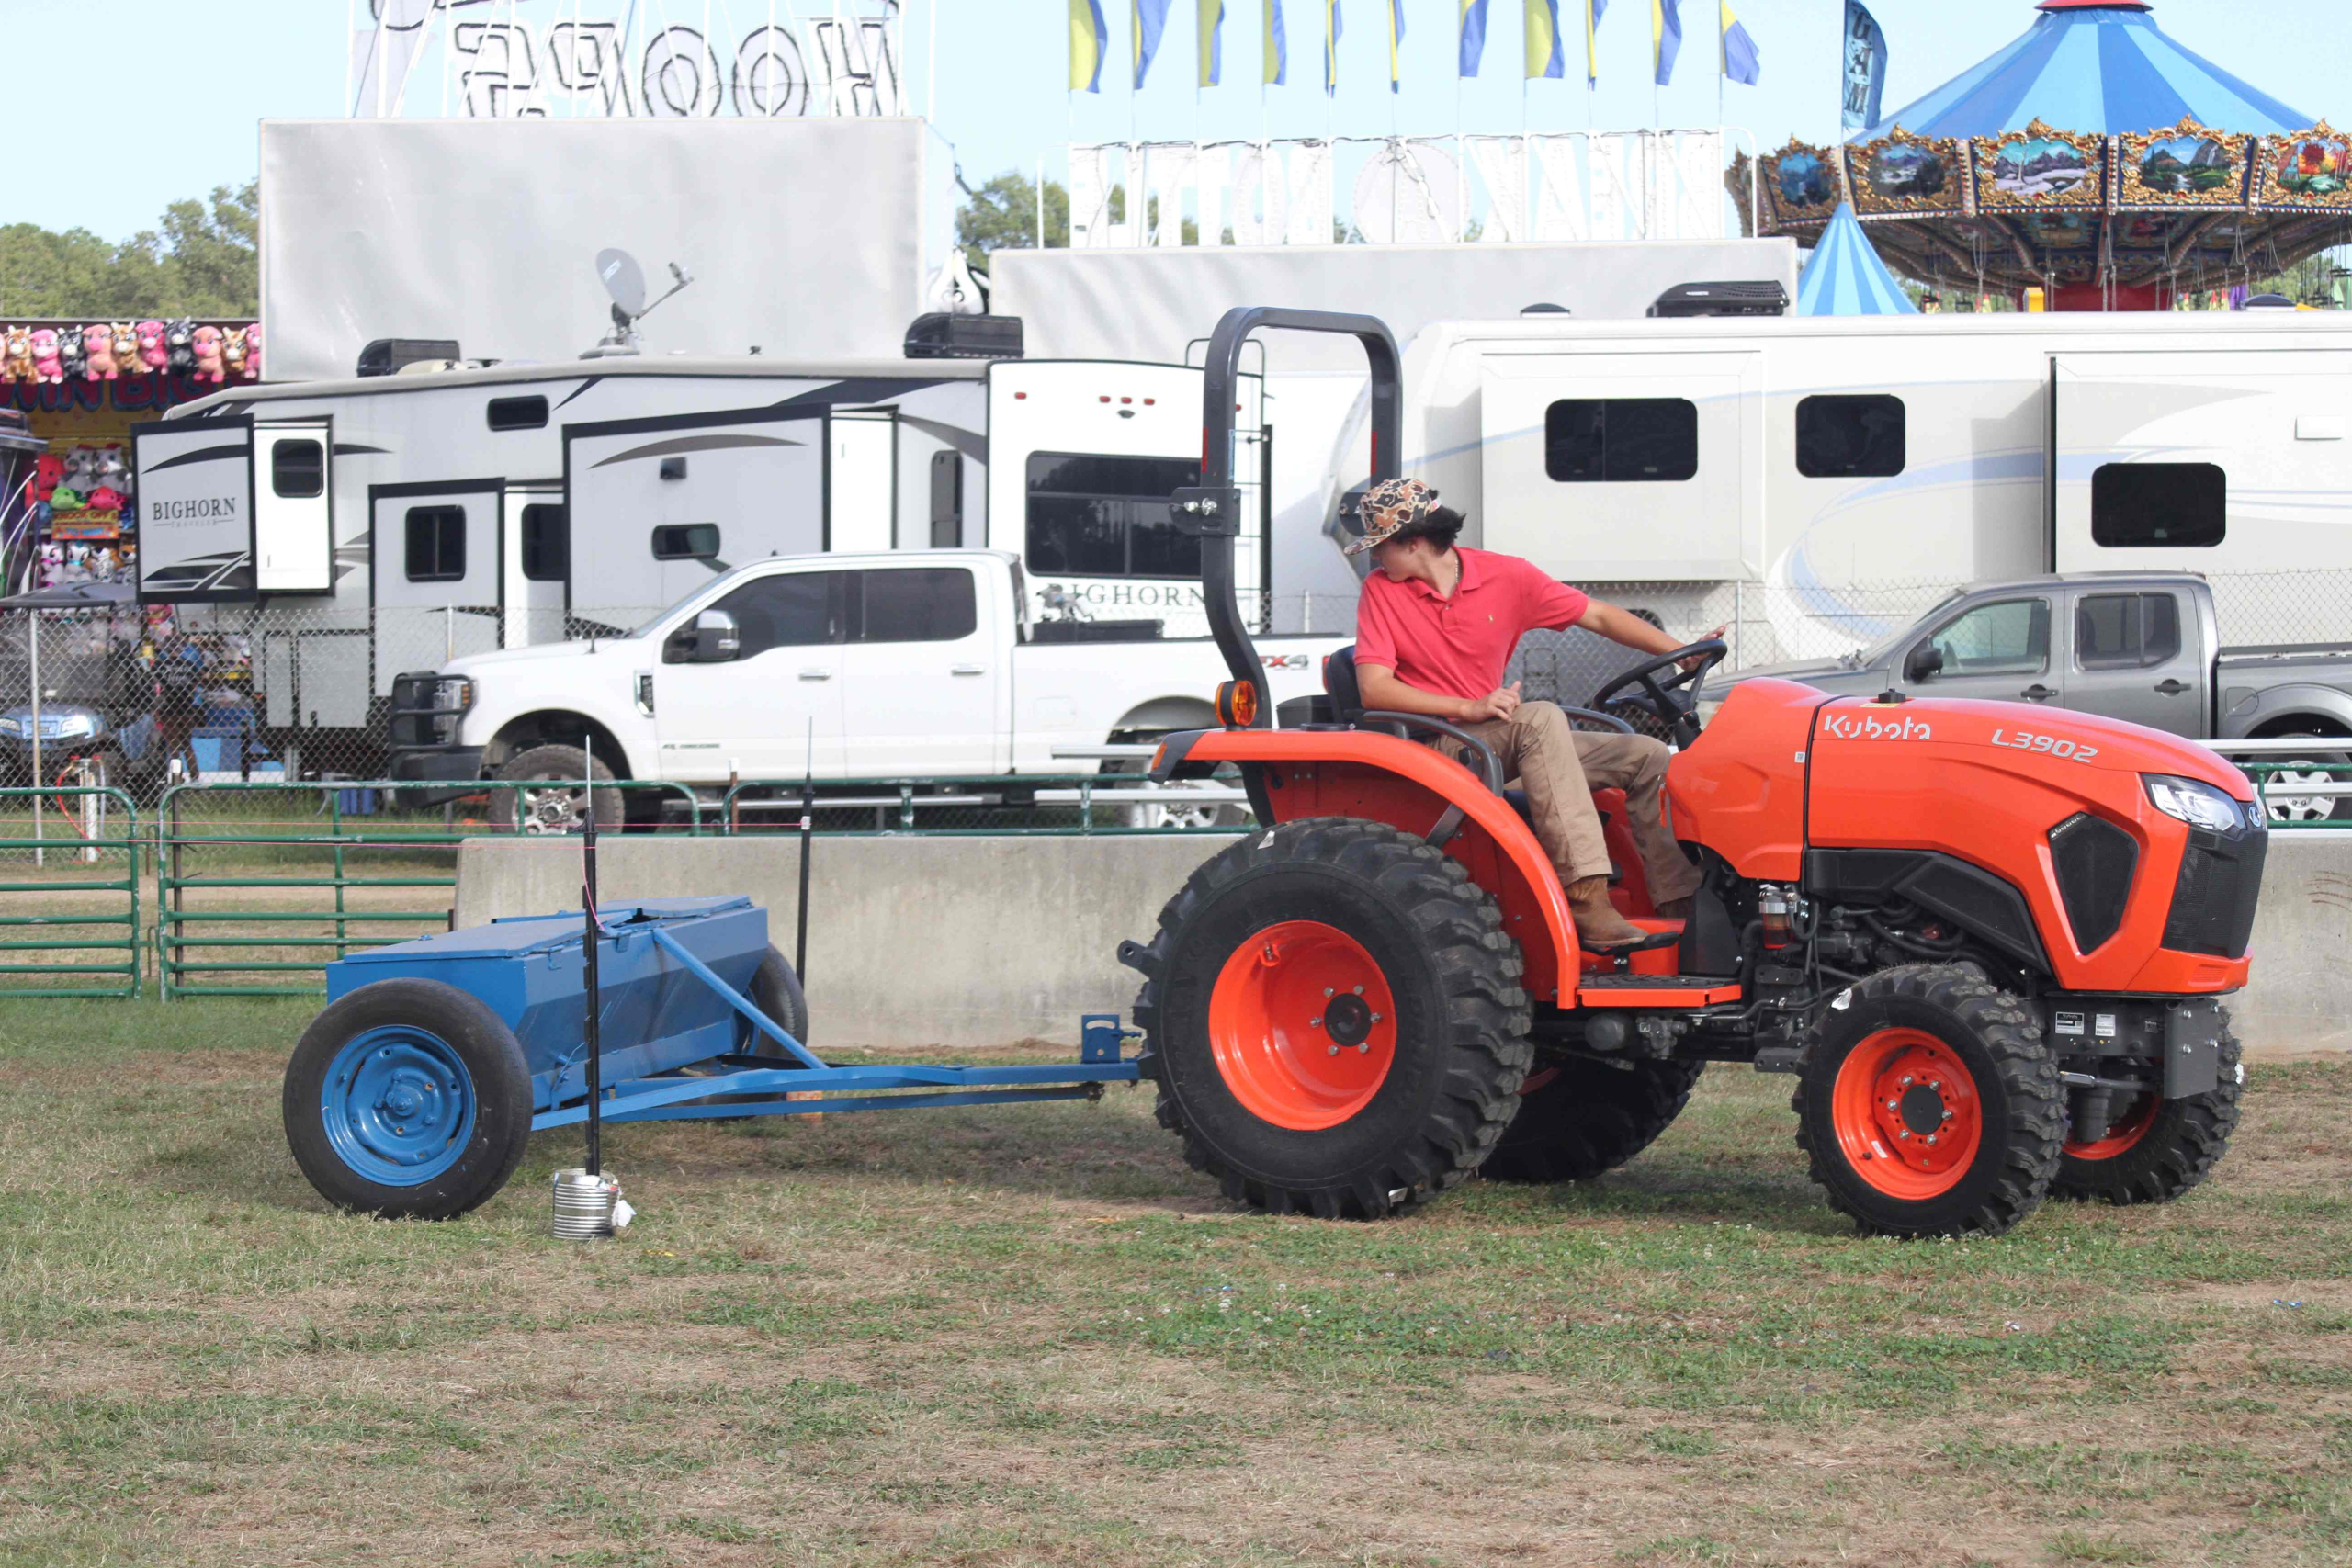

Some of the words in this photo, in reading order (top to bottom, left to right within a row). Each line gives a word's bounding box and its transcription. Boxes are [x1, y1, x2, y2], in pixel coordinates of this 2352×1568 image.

[153, 497, 236, 521] BIGHORN
[1824, 715, 1931, 740] Kubota
[1991, 728, 2098, 763] L3902
